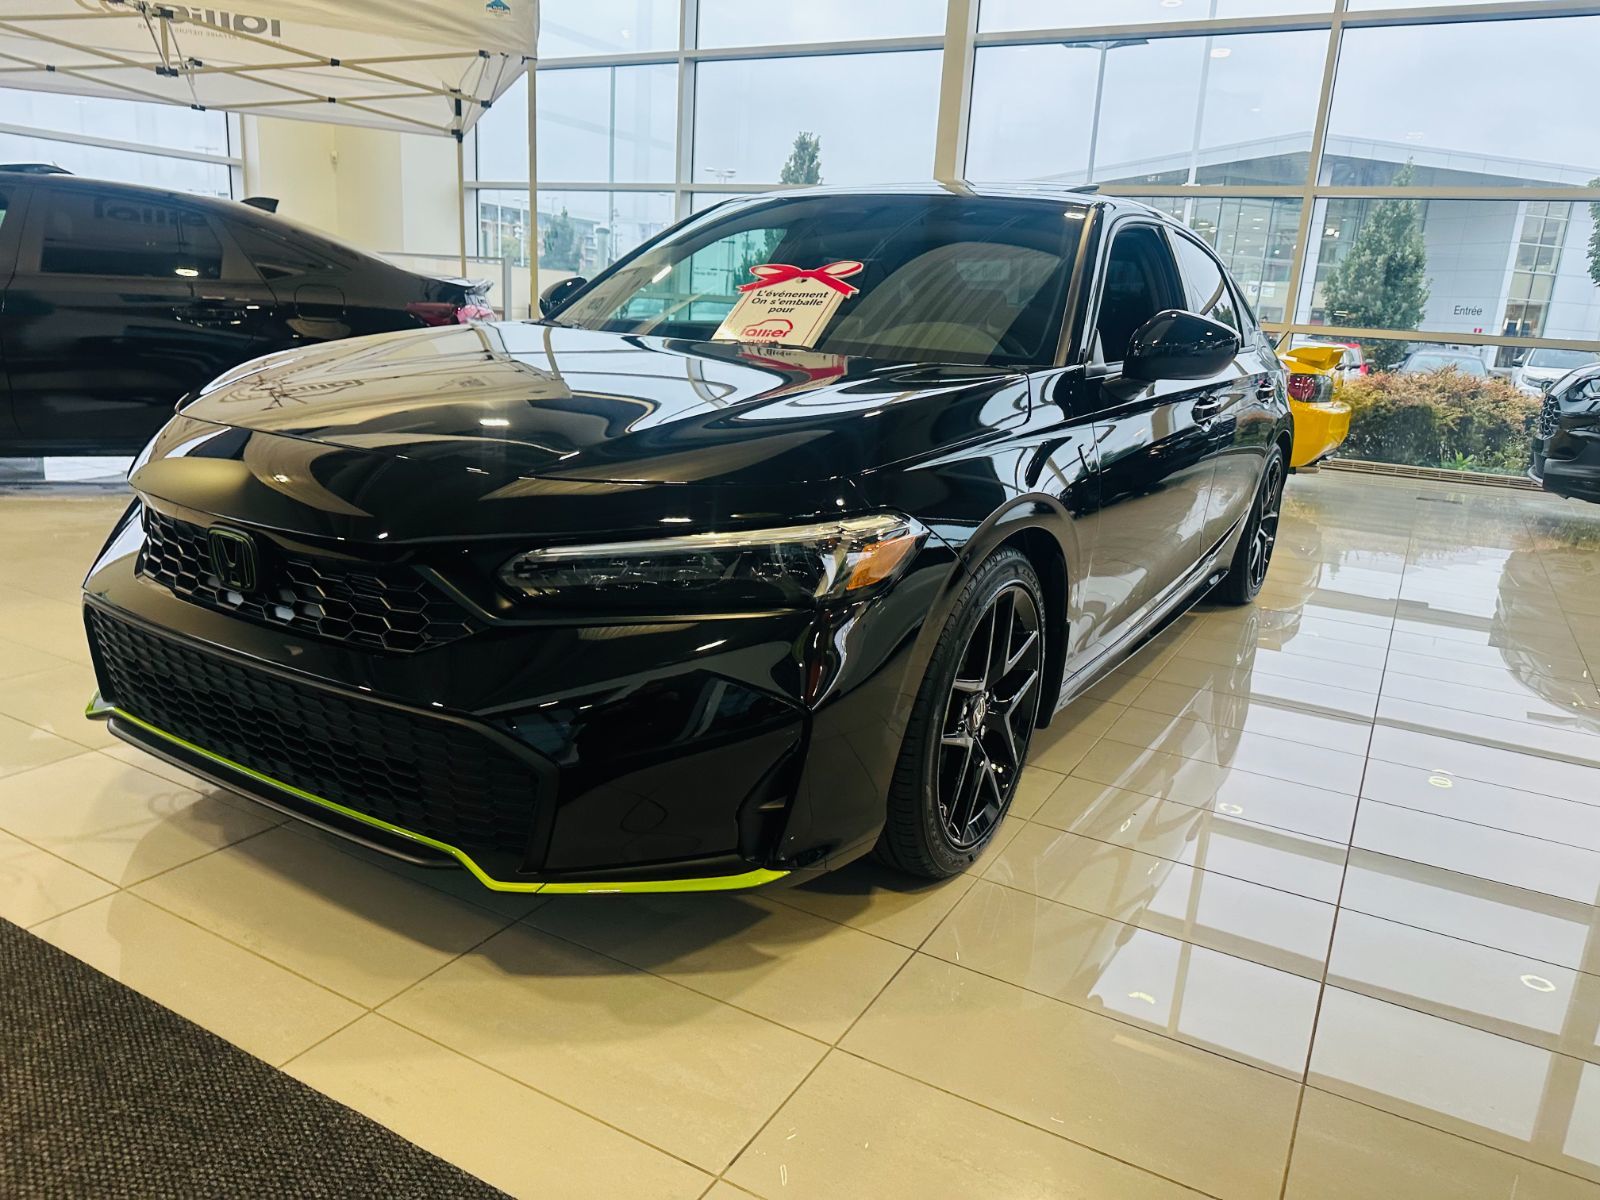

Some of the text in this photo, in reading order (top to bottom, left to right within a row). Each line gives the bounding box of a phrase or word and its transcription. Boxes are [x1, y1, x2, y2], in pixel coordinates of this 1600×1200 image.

[756, 290, 829, 298] L'événement
[751, 297, 824, 306] On s'emballe
[1453, 305, 1483, 316] Entrée
